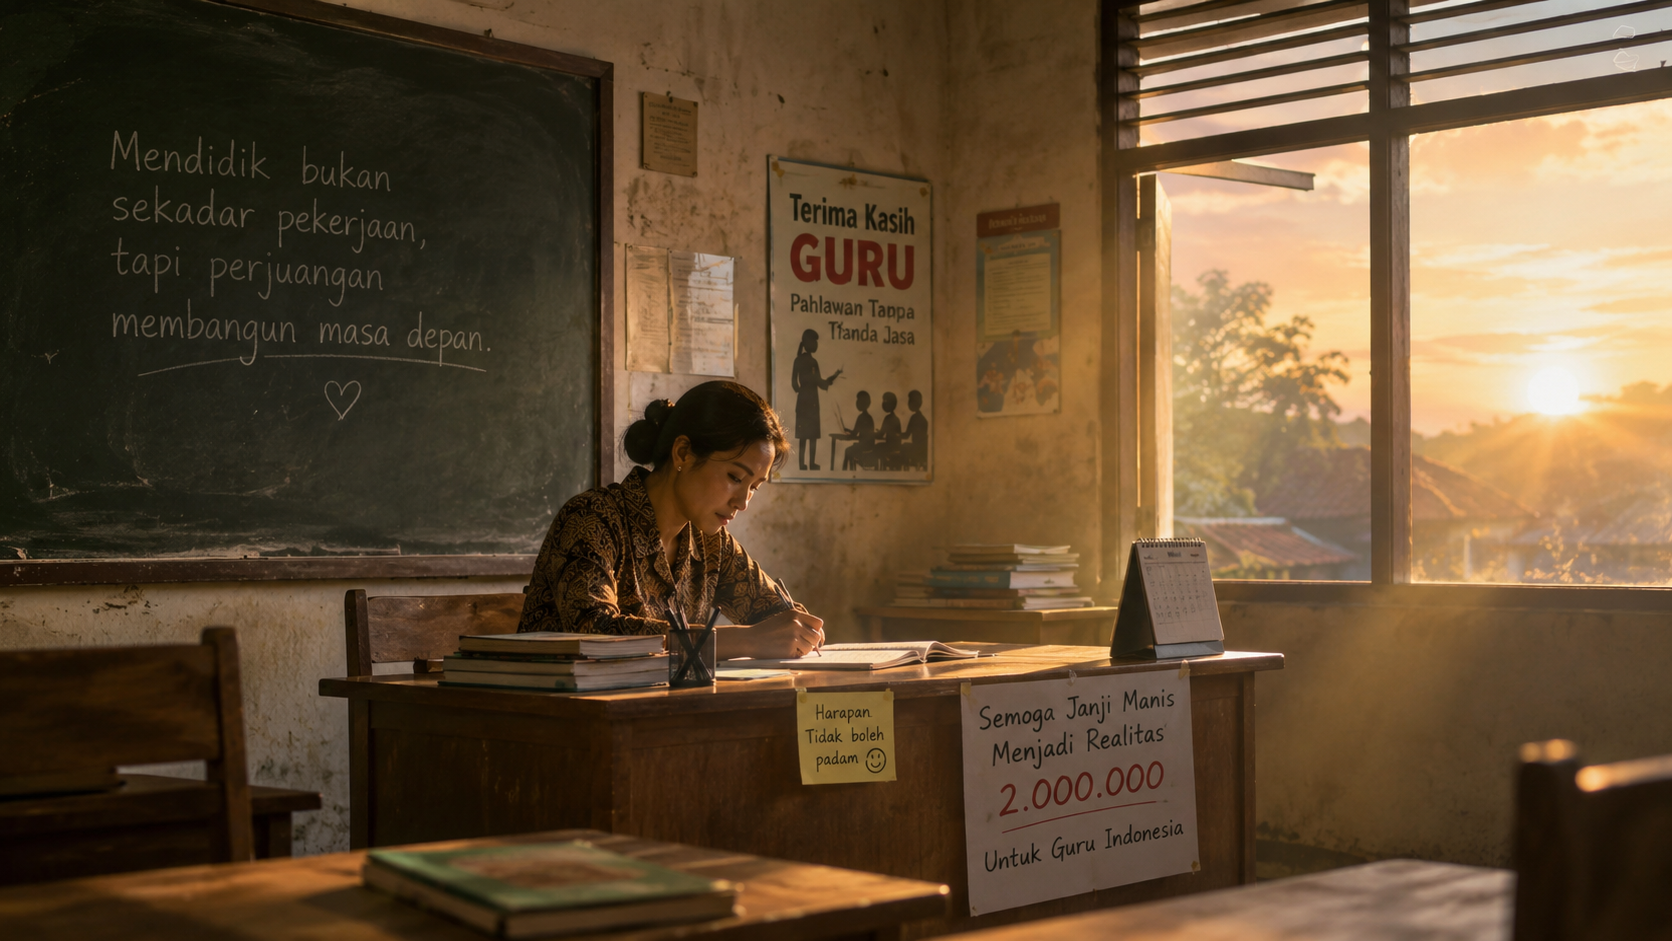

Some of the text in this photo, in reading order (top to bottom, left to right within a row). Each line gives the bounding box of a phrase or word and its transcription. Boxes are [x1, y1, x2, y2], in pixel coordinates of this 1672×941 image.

[111, 130, 391, 192] Mendidik bukan
[112, 185, 426, 253] sekadar pekerjaan,
[789, 193, 914, 235] Terima Kasih
[110, 238, 384, 307] tapi perjuangan
[790, 232, 914, 290] GURU
[790, 293, 863, 316] Pahlawan
[112, 300, 492, 367] membangun masa depan.
[883, 326, 915, 345] Jasa
[815, 704, 871, 724] Harapan
[979, 689, 1175, 732] Semoga Janji Manis
[805, 726, 885, 744] Tidak boleh
[992, 725, 1164, 769] Menjadi Realitas
[816, 750, 859, 773] padam
[999, 760, 1165, 817] 2.000.000
[984, 819, 1184, 873] Untuk Guru Indonesia
